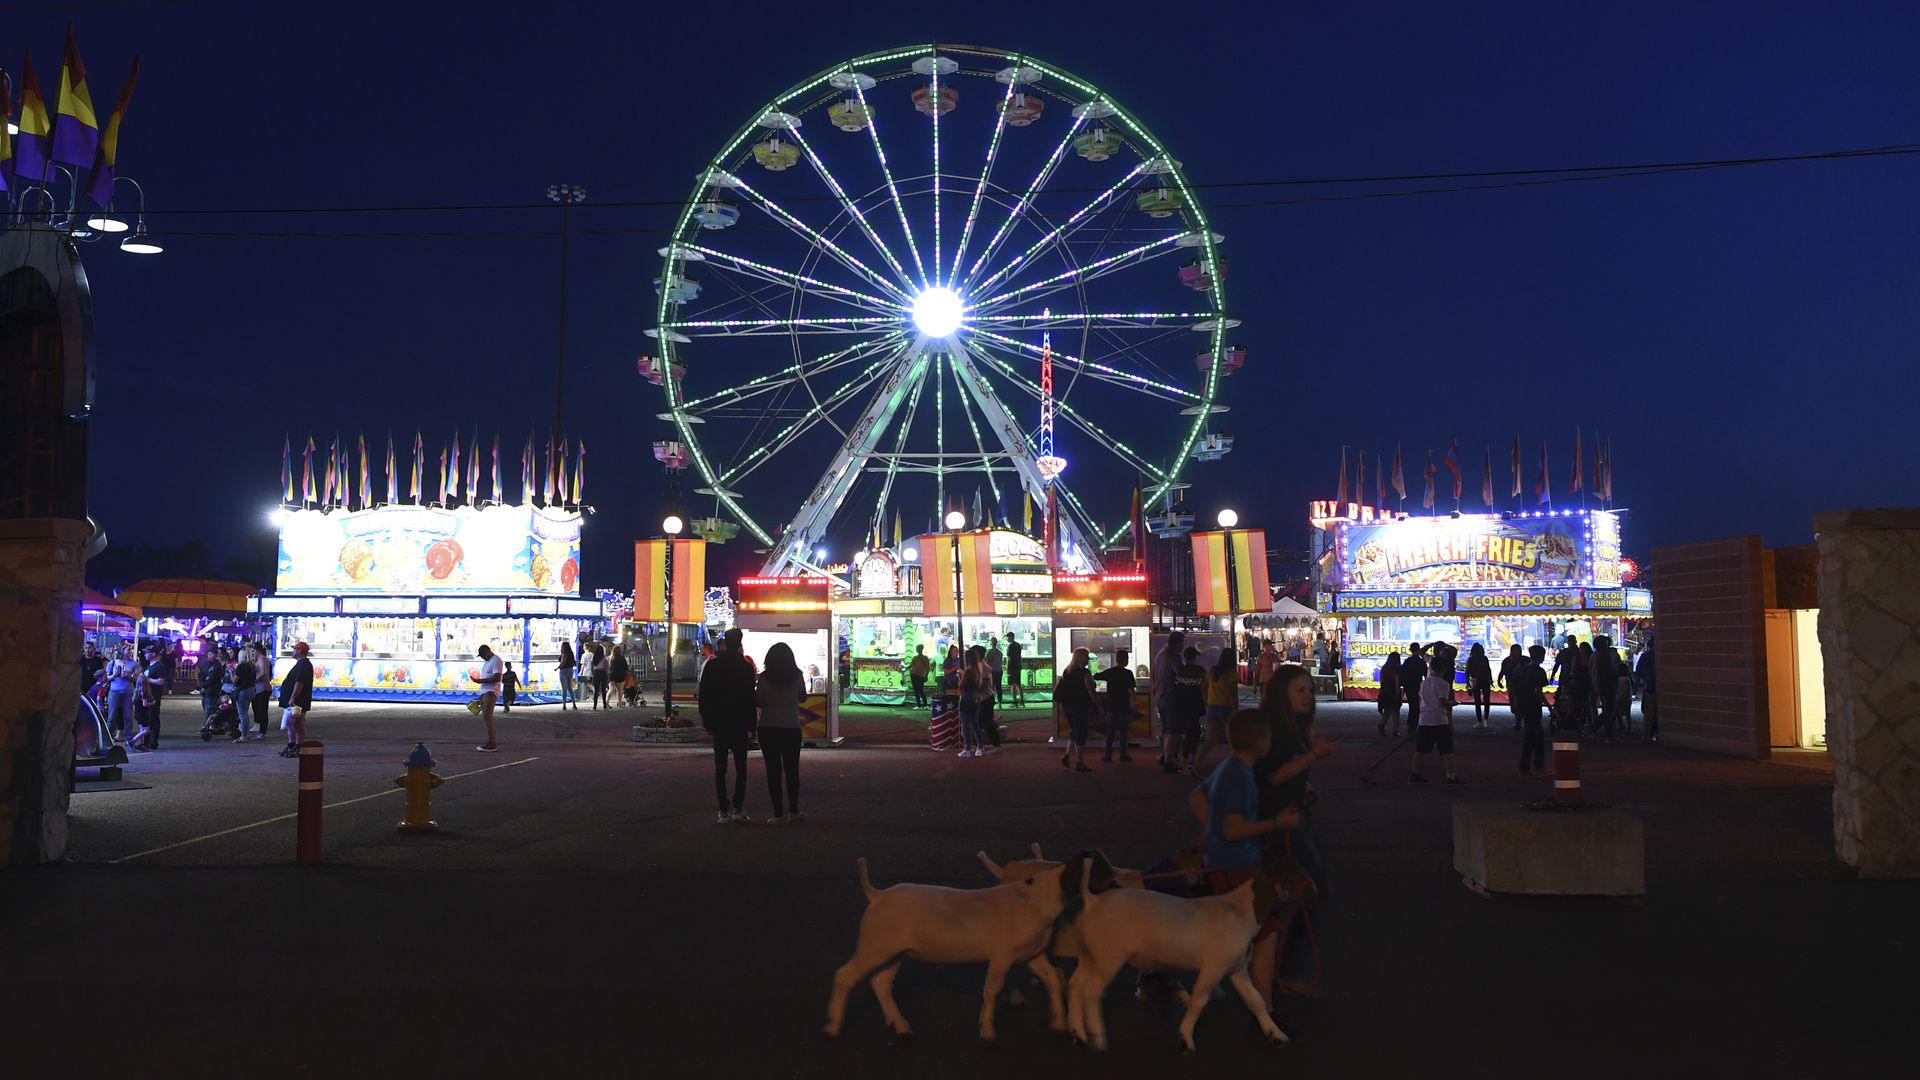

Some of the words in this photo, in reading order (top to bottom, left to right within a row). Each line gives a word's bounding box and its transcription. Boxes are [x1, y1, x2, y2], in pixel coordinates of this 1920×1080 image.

[1385, 534, 1468, 576] FRENCH
[1475, 533, 1539, 570] FRIES
[1340, 595, 1399, 609] RIBBON
[1401, 595, 1444, 609] FRIES
[1472, 594, 1516, 608] CORN
[1519, 593, 1566, 607] DOGS
[1588, 592, 1604, 600] ICE
[1605, 592, 1625, 600] COLD
[1594, 600, 1622, 608] DRINKS
